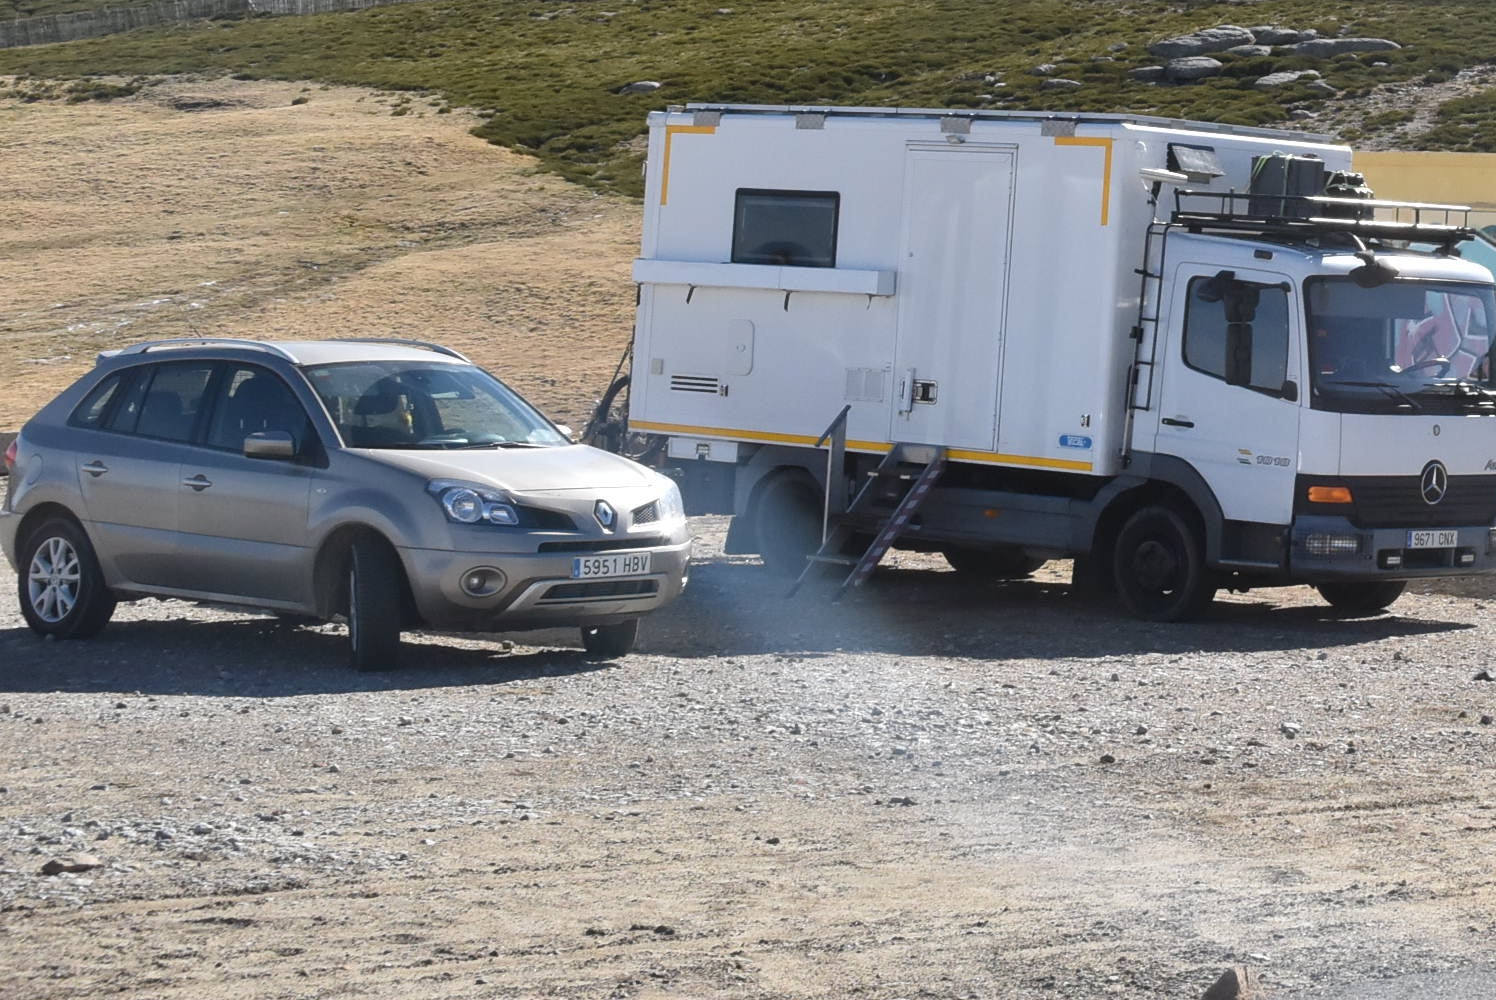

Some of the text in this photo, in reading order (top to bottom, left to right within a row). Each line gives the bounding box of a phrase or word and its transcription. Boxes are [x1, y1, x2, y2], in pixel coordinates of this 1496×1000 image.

[1414, 531, 1455, 546] 9671 CNX
[583, 555, 648, 575] 5951 HBV
